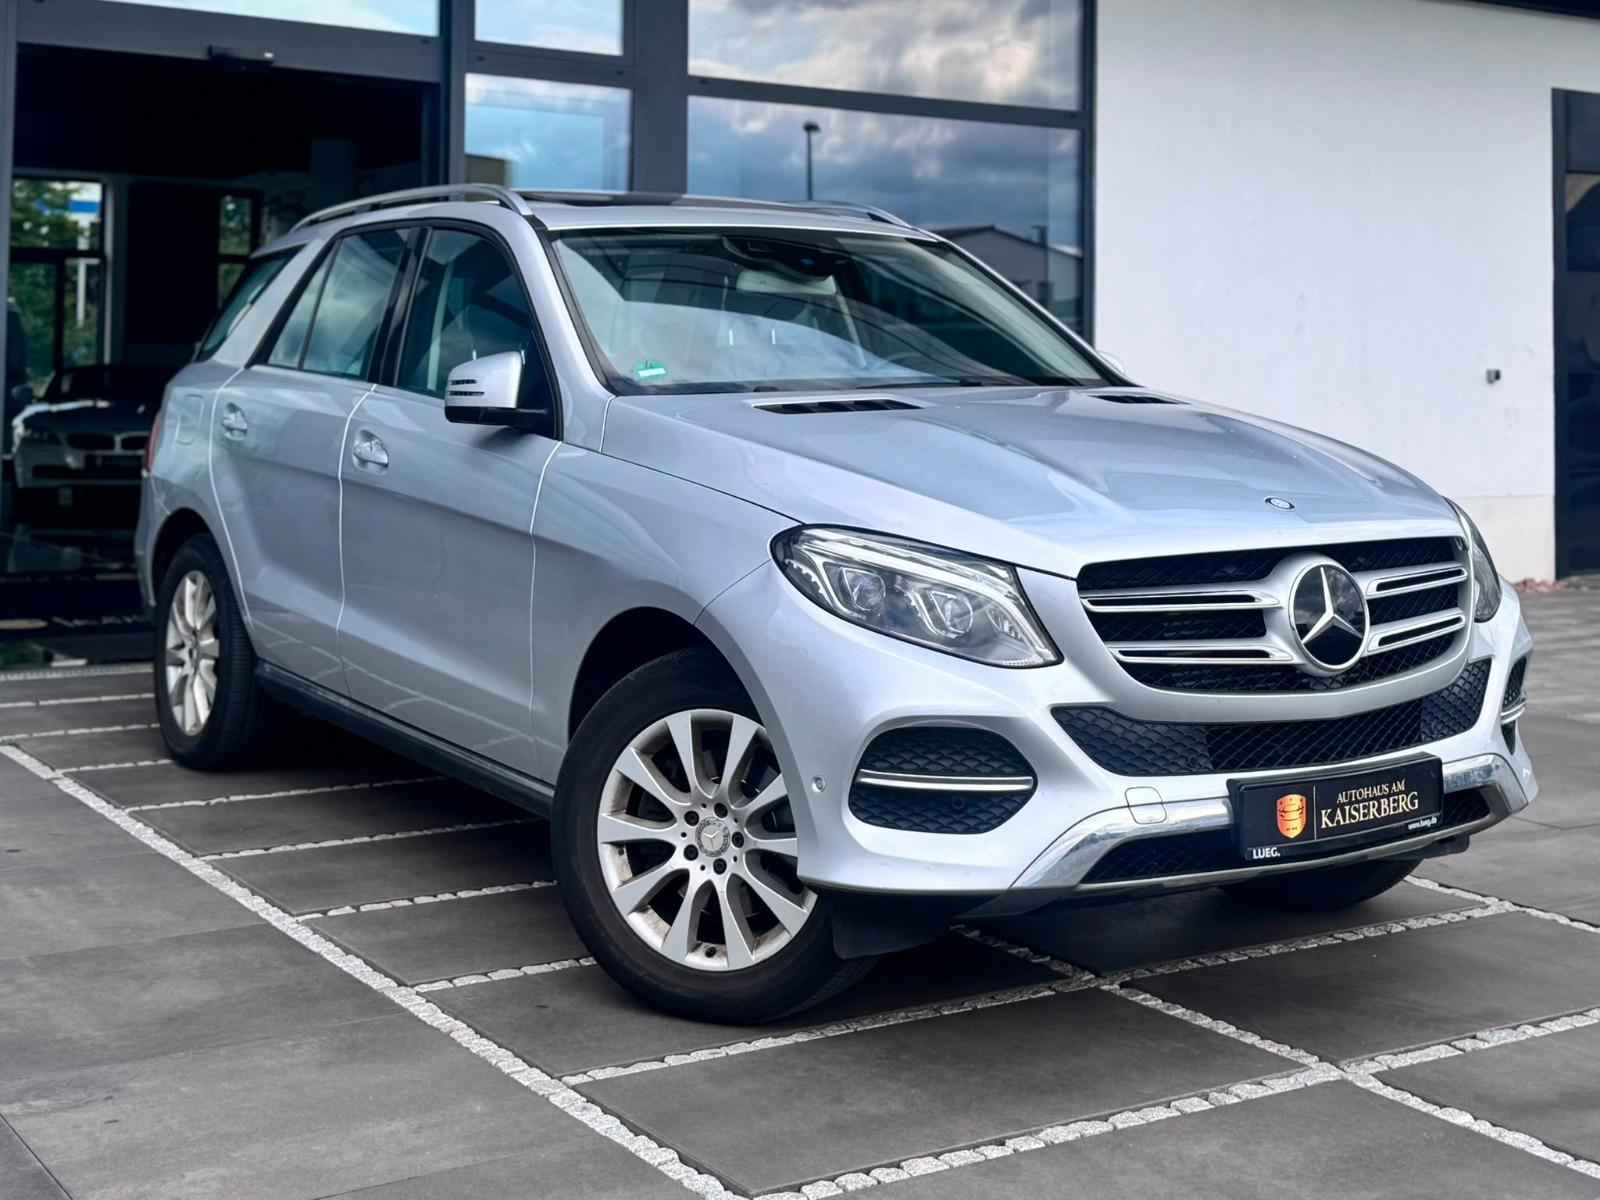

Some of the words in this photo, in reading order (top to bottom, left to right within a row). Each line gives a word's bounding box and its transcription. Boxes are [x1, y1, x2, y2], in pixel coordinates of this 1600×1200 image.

[1336, 783, 1389, 804] AUTOHAUS
[1391, 778, 1406, 793] AM
[1321, 791, 1419, 829] KAISERBERG
[1252, 846, 1281, 860] LUEG.
